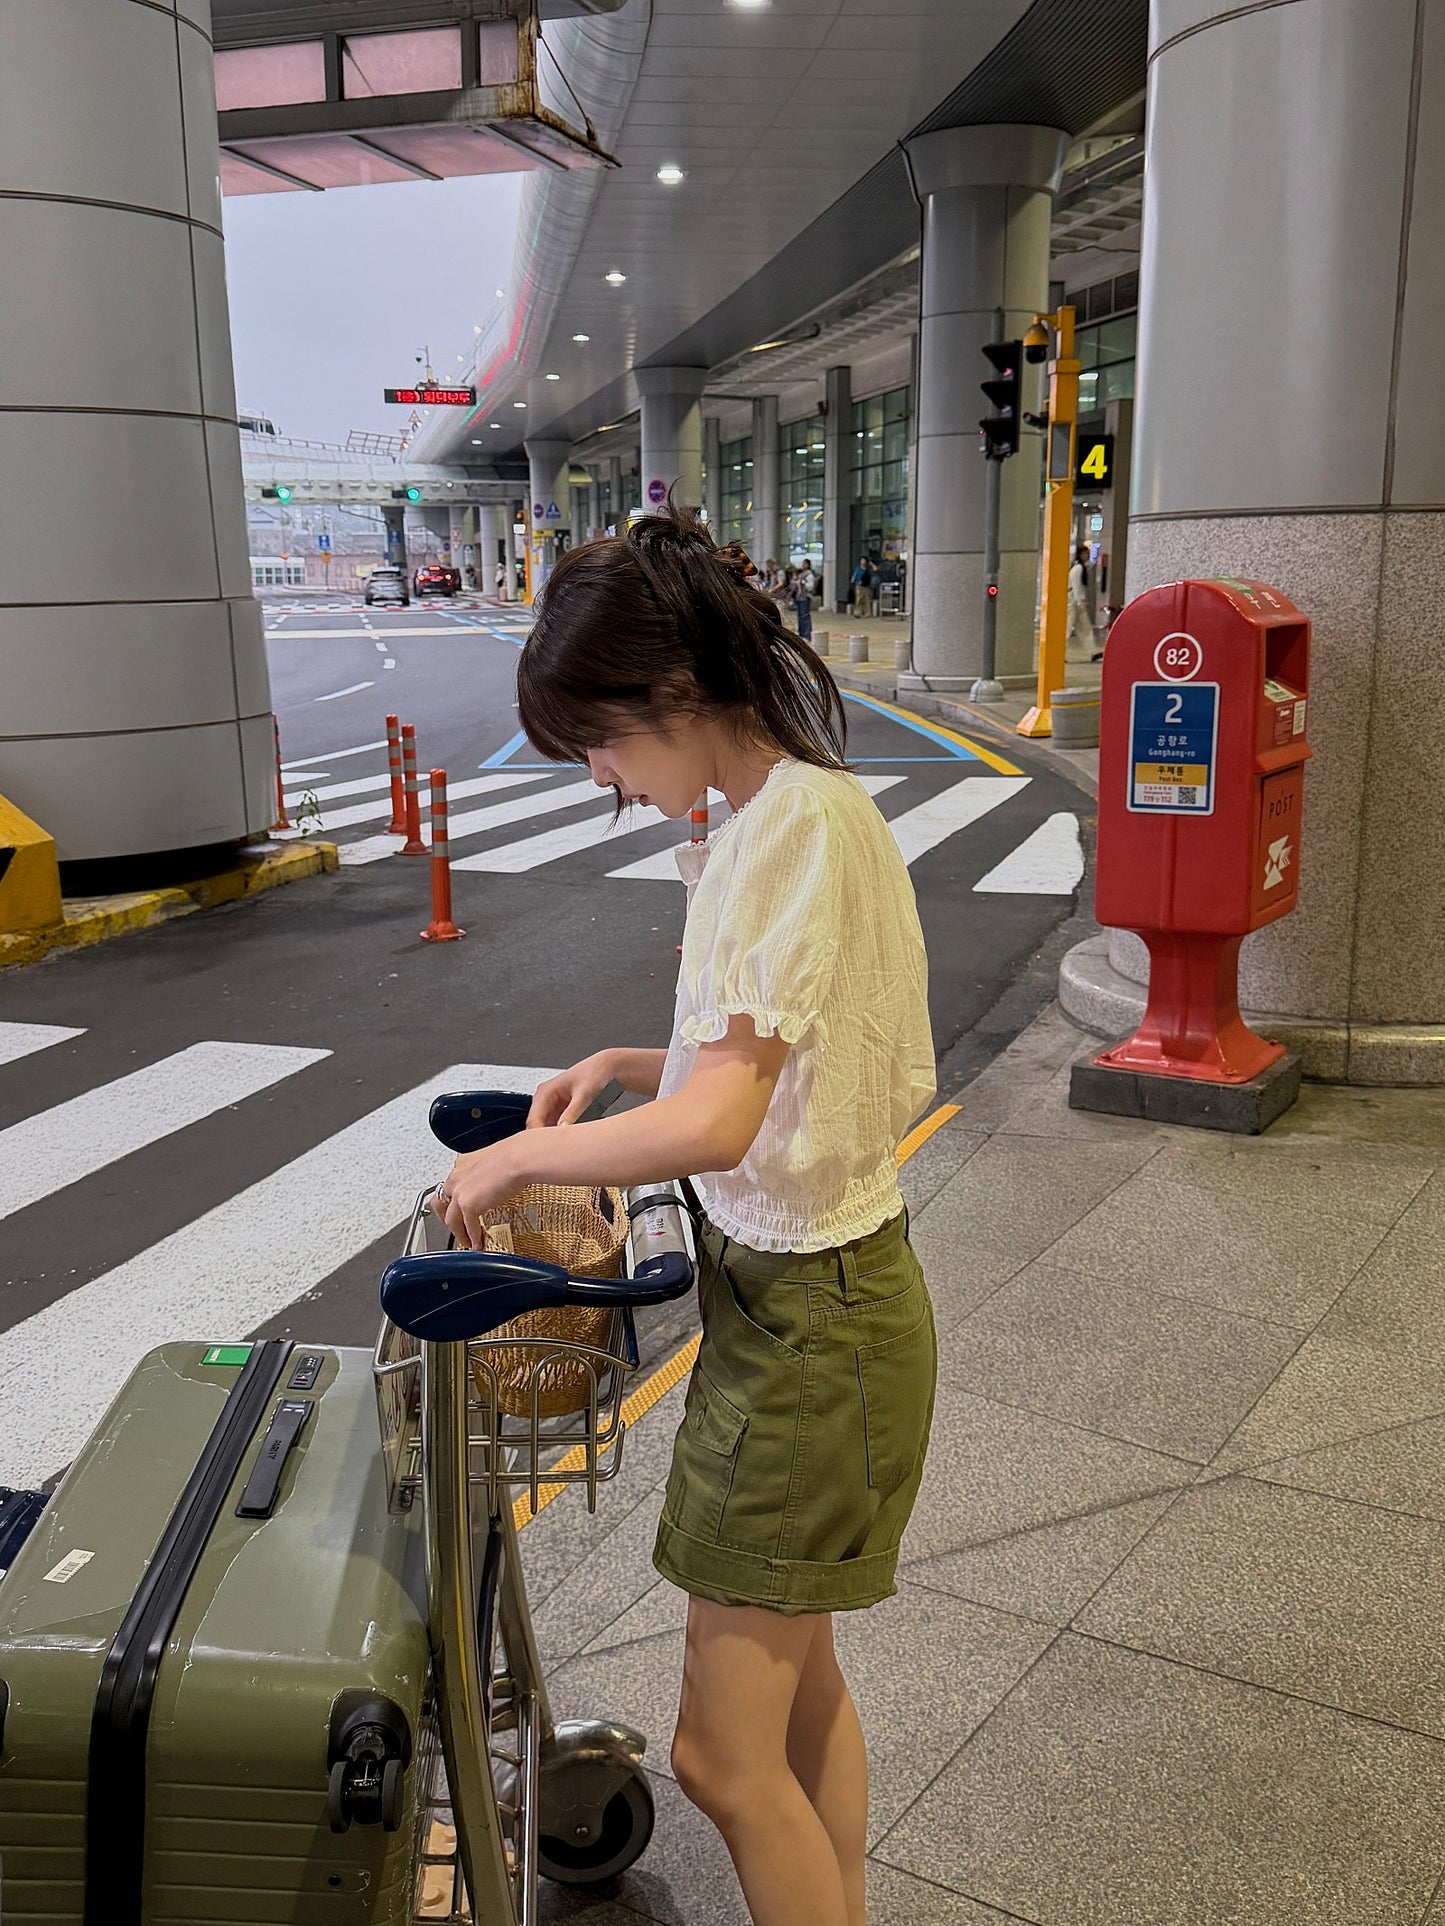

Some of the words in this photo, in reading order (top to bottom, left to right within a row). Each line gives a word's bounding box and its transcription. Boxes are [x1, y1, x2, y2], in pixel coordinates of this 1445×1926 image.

[1081, 444, 1108, 479] 4
[1166, 648, 1190, 665] 82
[1164, 693, 1183, 723] 2
[1157, 734, 1188, 747] 공항로
[1148, 748, 1196, 758] Gonghang-ro
[1157, 765, 1184, 776] 우체통
[1269, 794, 1294, 819] POST
